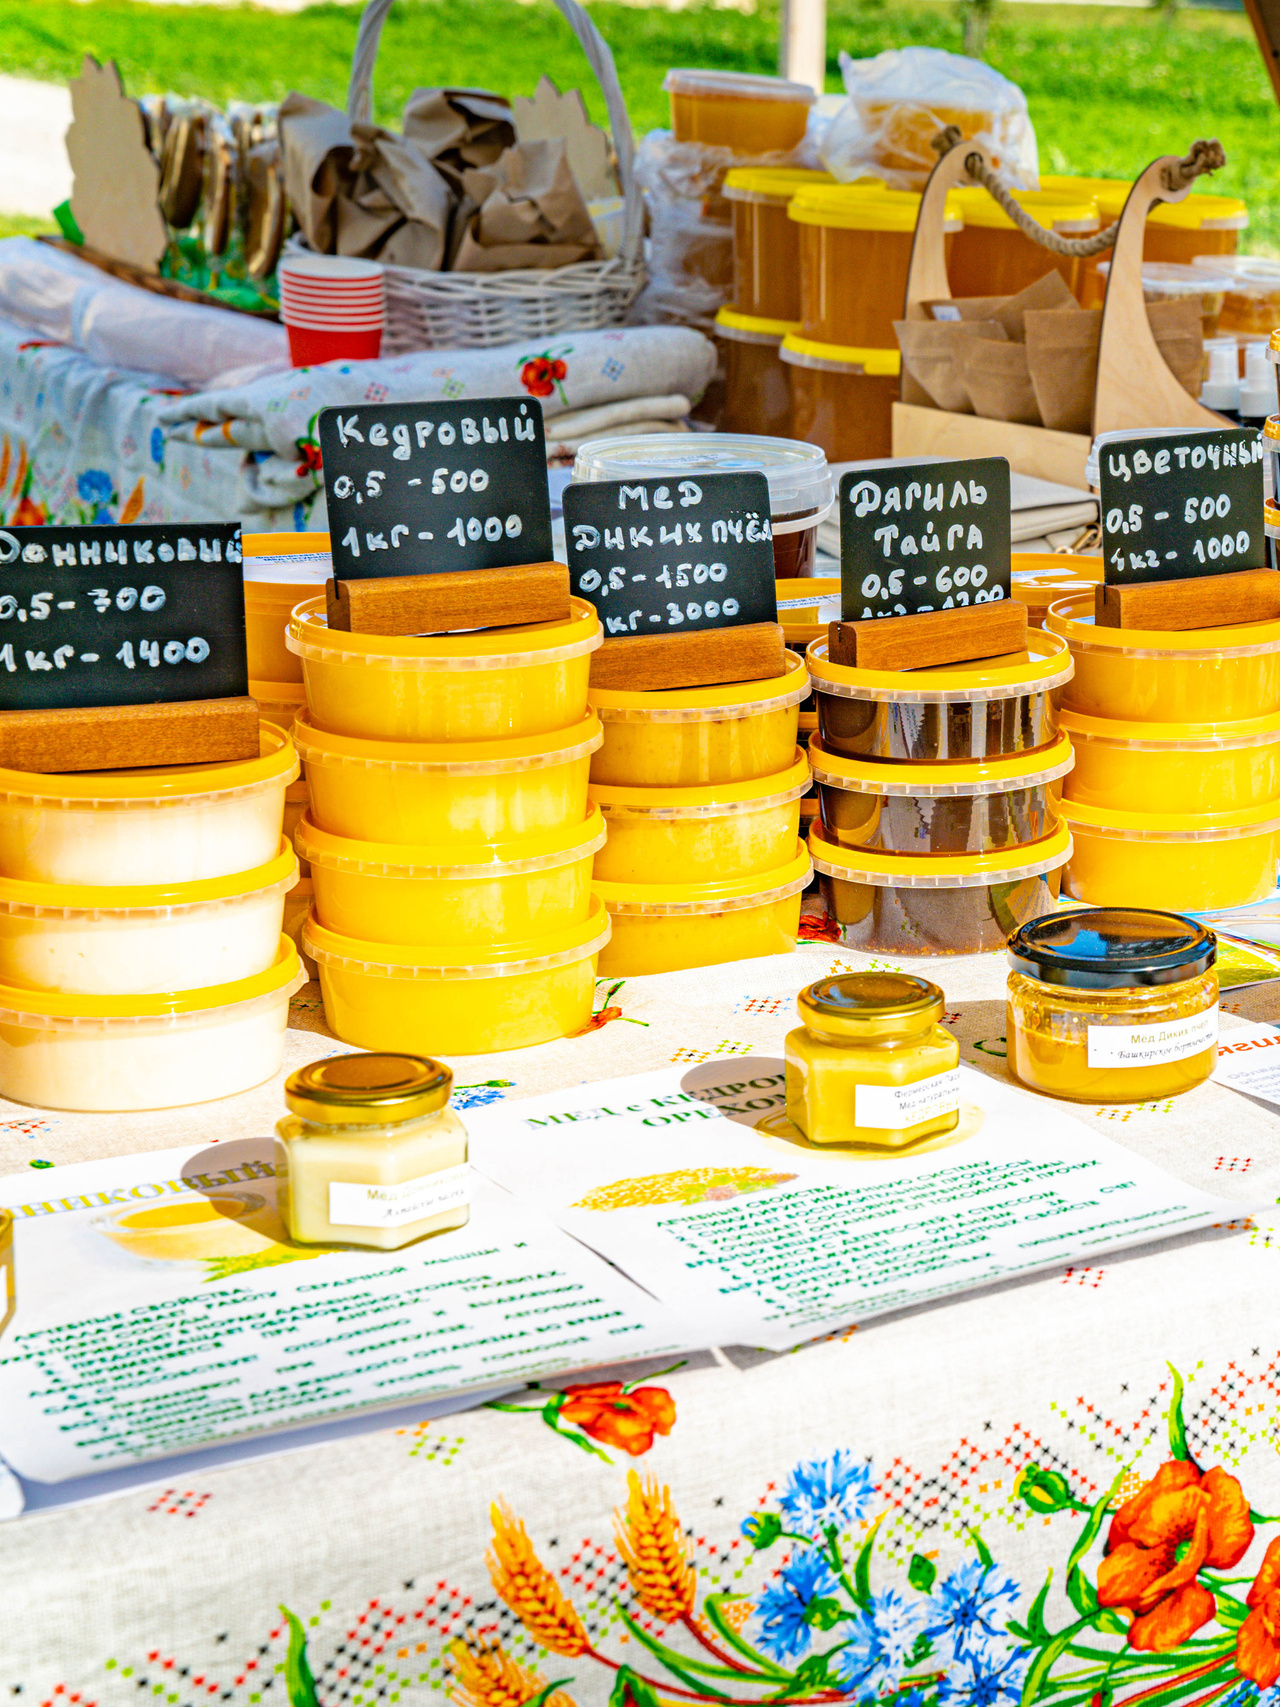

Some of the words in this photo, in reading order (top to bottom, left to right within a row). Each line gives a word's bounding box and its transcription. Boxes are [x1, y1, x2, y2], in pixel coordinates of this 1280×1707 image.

[336, 403, 536, 461] Кедровый
[333, 469, 387, 505] 0,5
[431, 467, 490, 495] 500
[849, 479, 988, 518] Дягиль
[446, 513, 523, 548] 1000
[1105, 503, 1144, 535] 0,5
[1184, 493, 1232, 524] 500
[1192, 530, 1250, 564] 1000
[655, 562, 728, 589] 1500
[935, 563, 988, 593] 600
[665, 597, 740, 626] 3000
[115, 636, 211, 670] 1400
[4, 1159, 276, 1221] НИКОВЫЙ
[656, 1206, 741, 1227] ЛЕЧЕБНЫЕ
